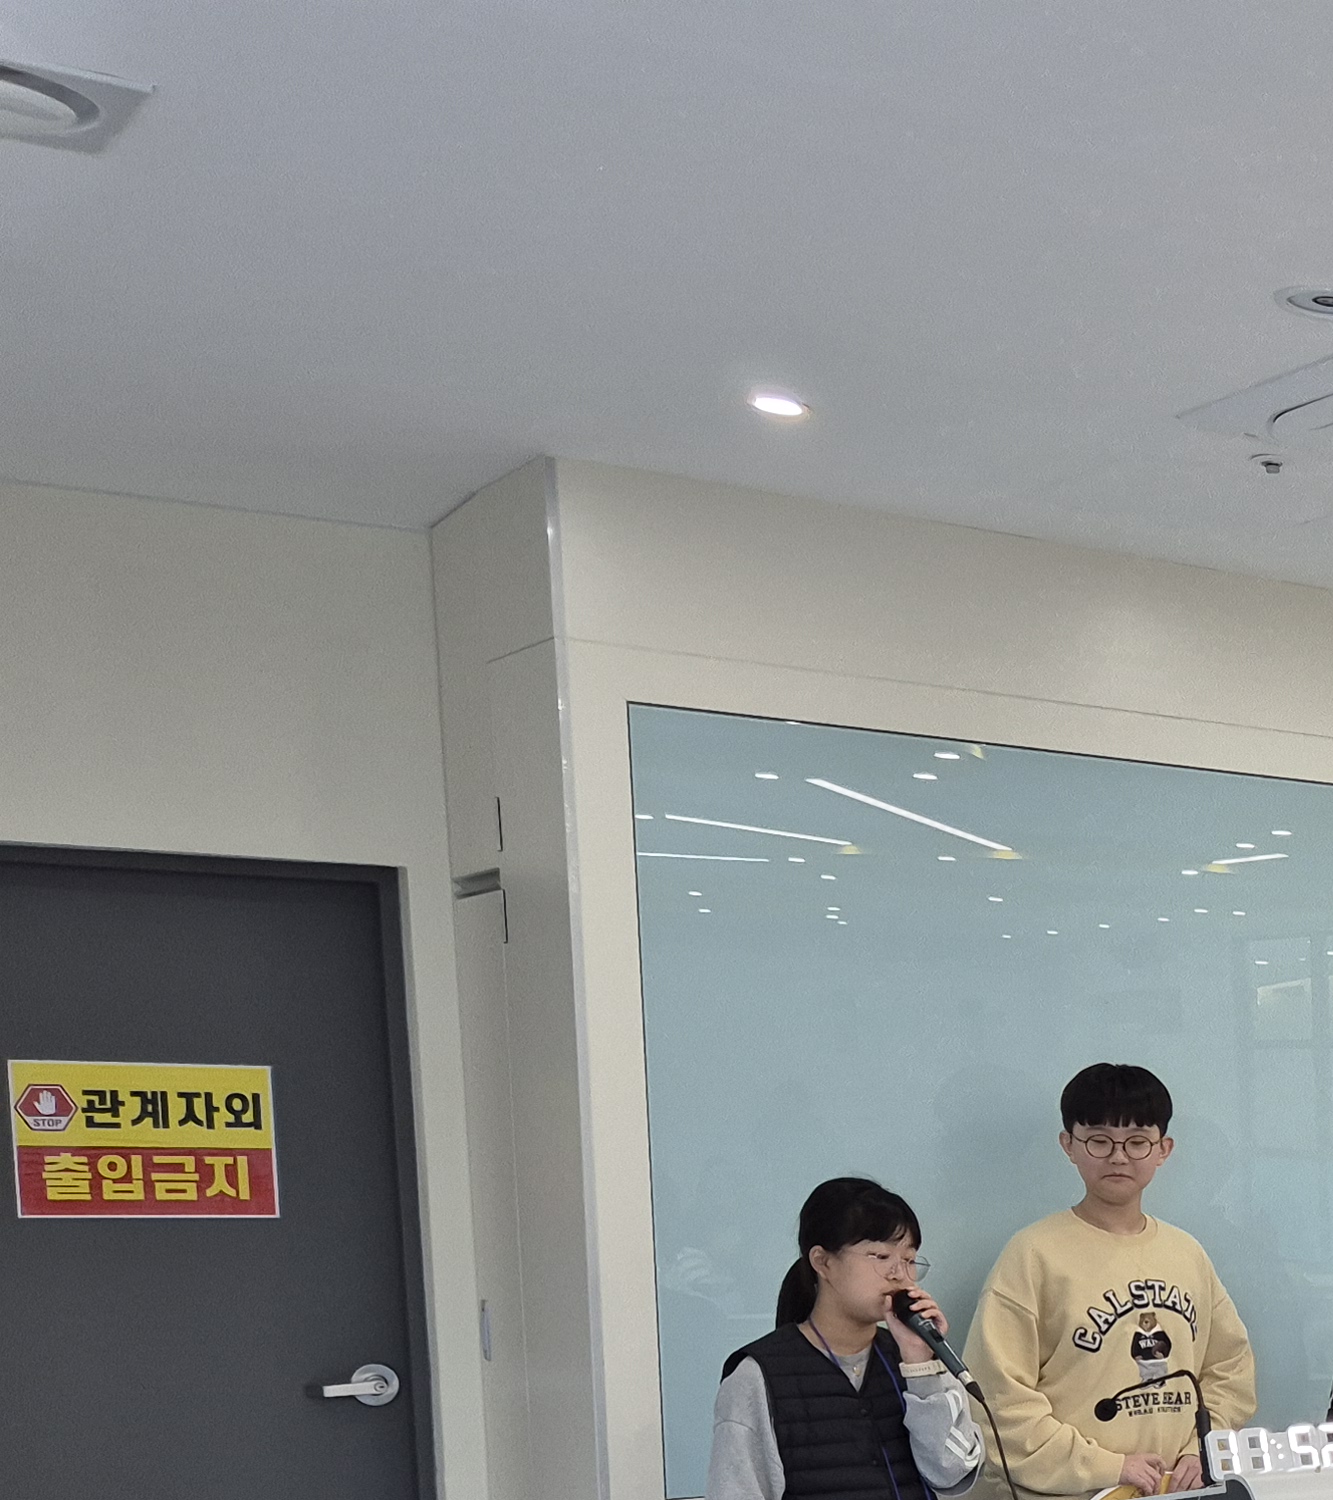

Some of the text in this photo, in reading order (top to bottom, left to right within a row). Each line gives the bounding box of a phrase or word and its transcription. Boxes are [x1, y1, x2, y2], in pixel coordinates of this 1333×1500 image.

[33, 1117, 62, 1128] STOP
[80, 1089, 264, 1131] 관계자외
[42, 1152, 252, 1202] 출입금지
